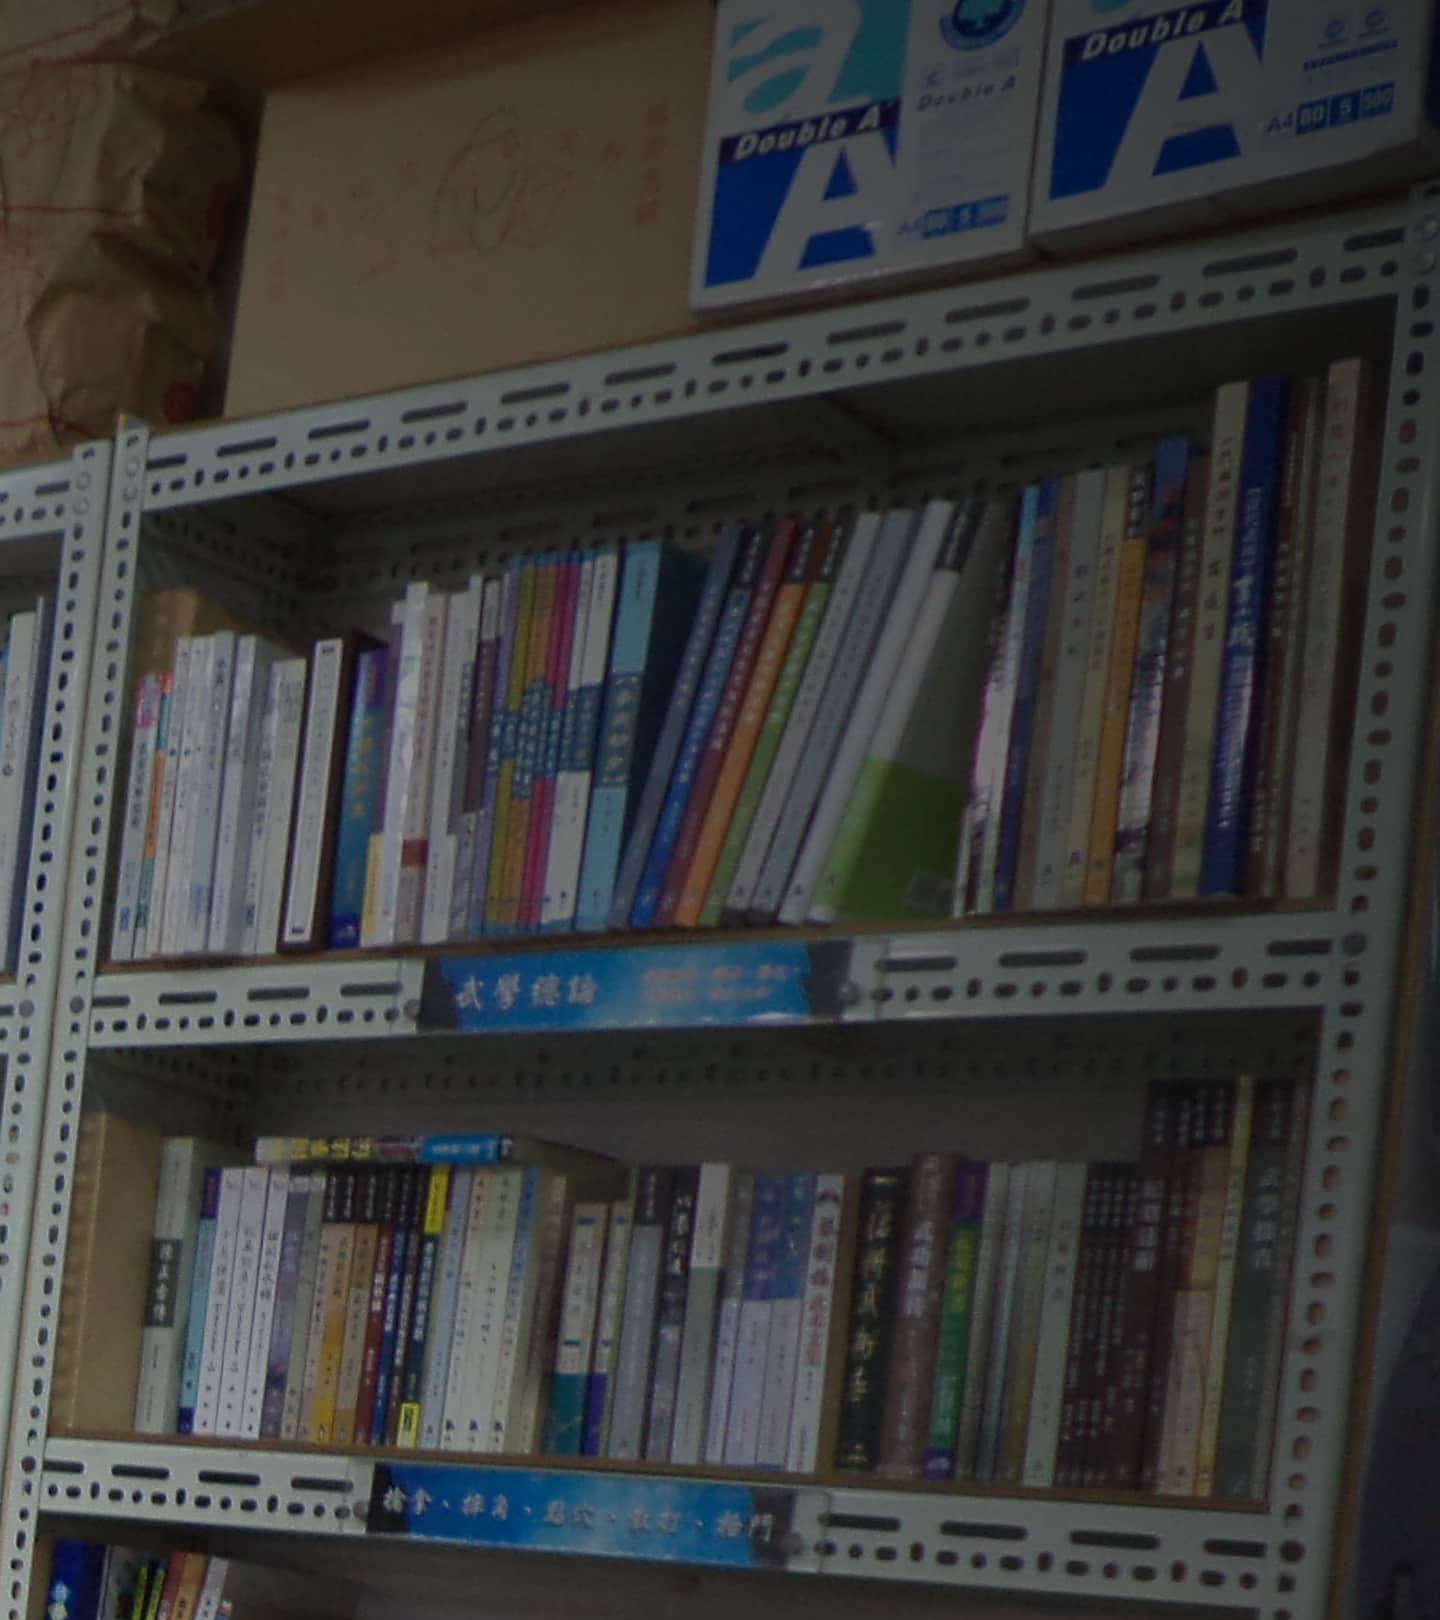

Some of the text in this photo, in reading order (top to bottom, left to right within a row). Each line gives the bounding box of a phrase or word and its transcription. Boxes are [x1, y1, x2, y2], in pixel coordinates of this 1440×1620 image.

[1081, 0, 1245, 61] Double A
[915, 75, 1017, 112] Double A
[733, 105, 881, 160] Double A
